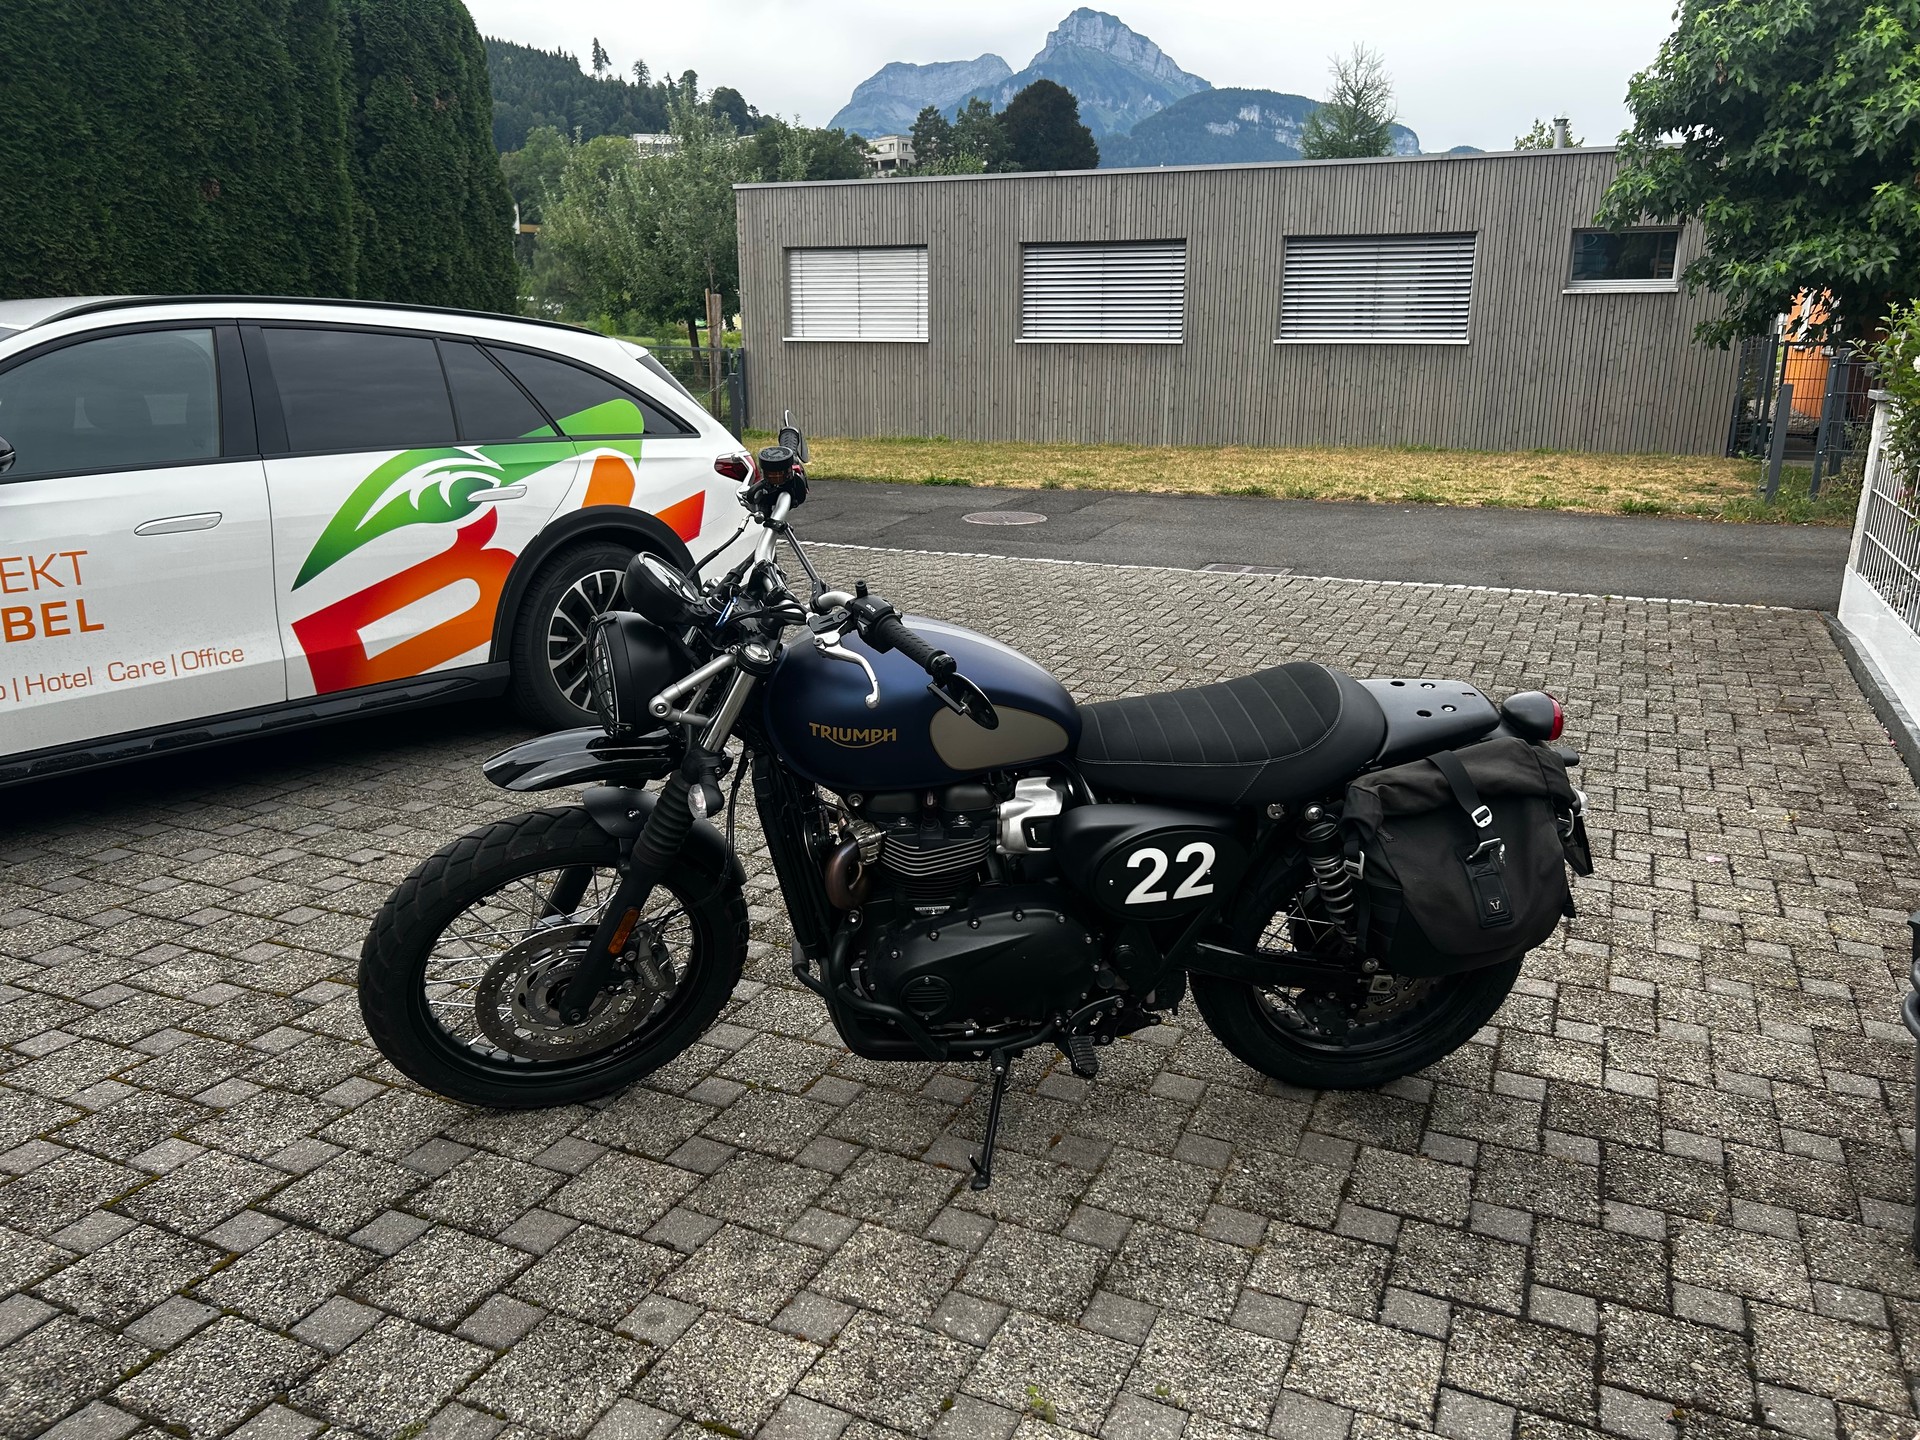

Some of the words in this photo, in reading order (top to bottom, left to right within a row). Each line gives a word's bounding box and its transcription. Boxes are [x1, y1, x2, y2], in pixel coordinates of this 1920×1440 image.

[0, 550, 88, 594] EKT
[1, 598, 105, 643] BEL
[808, 722, 897, 748] TRIUMPH
[1125, 842, 1217, 905] 22
